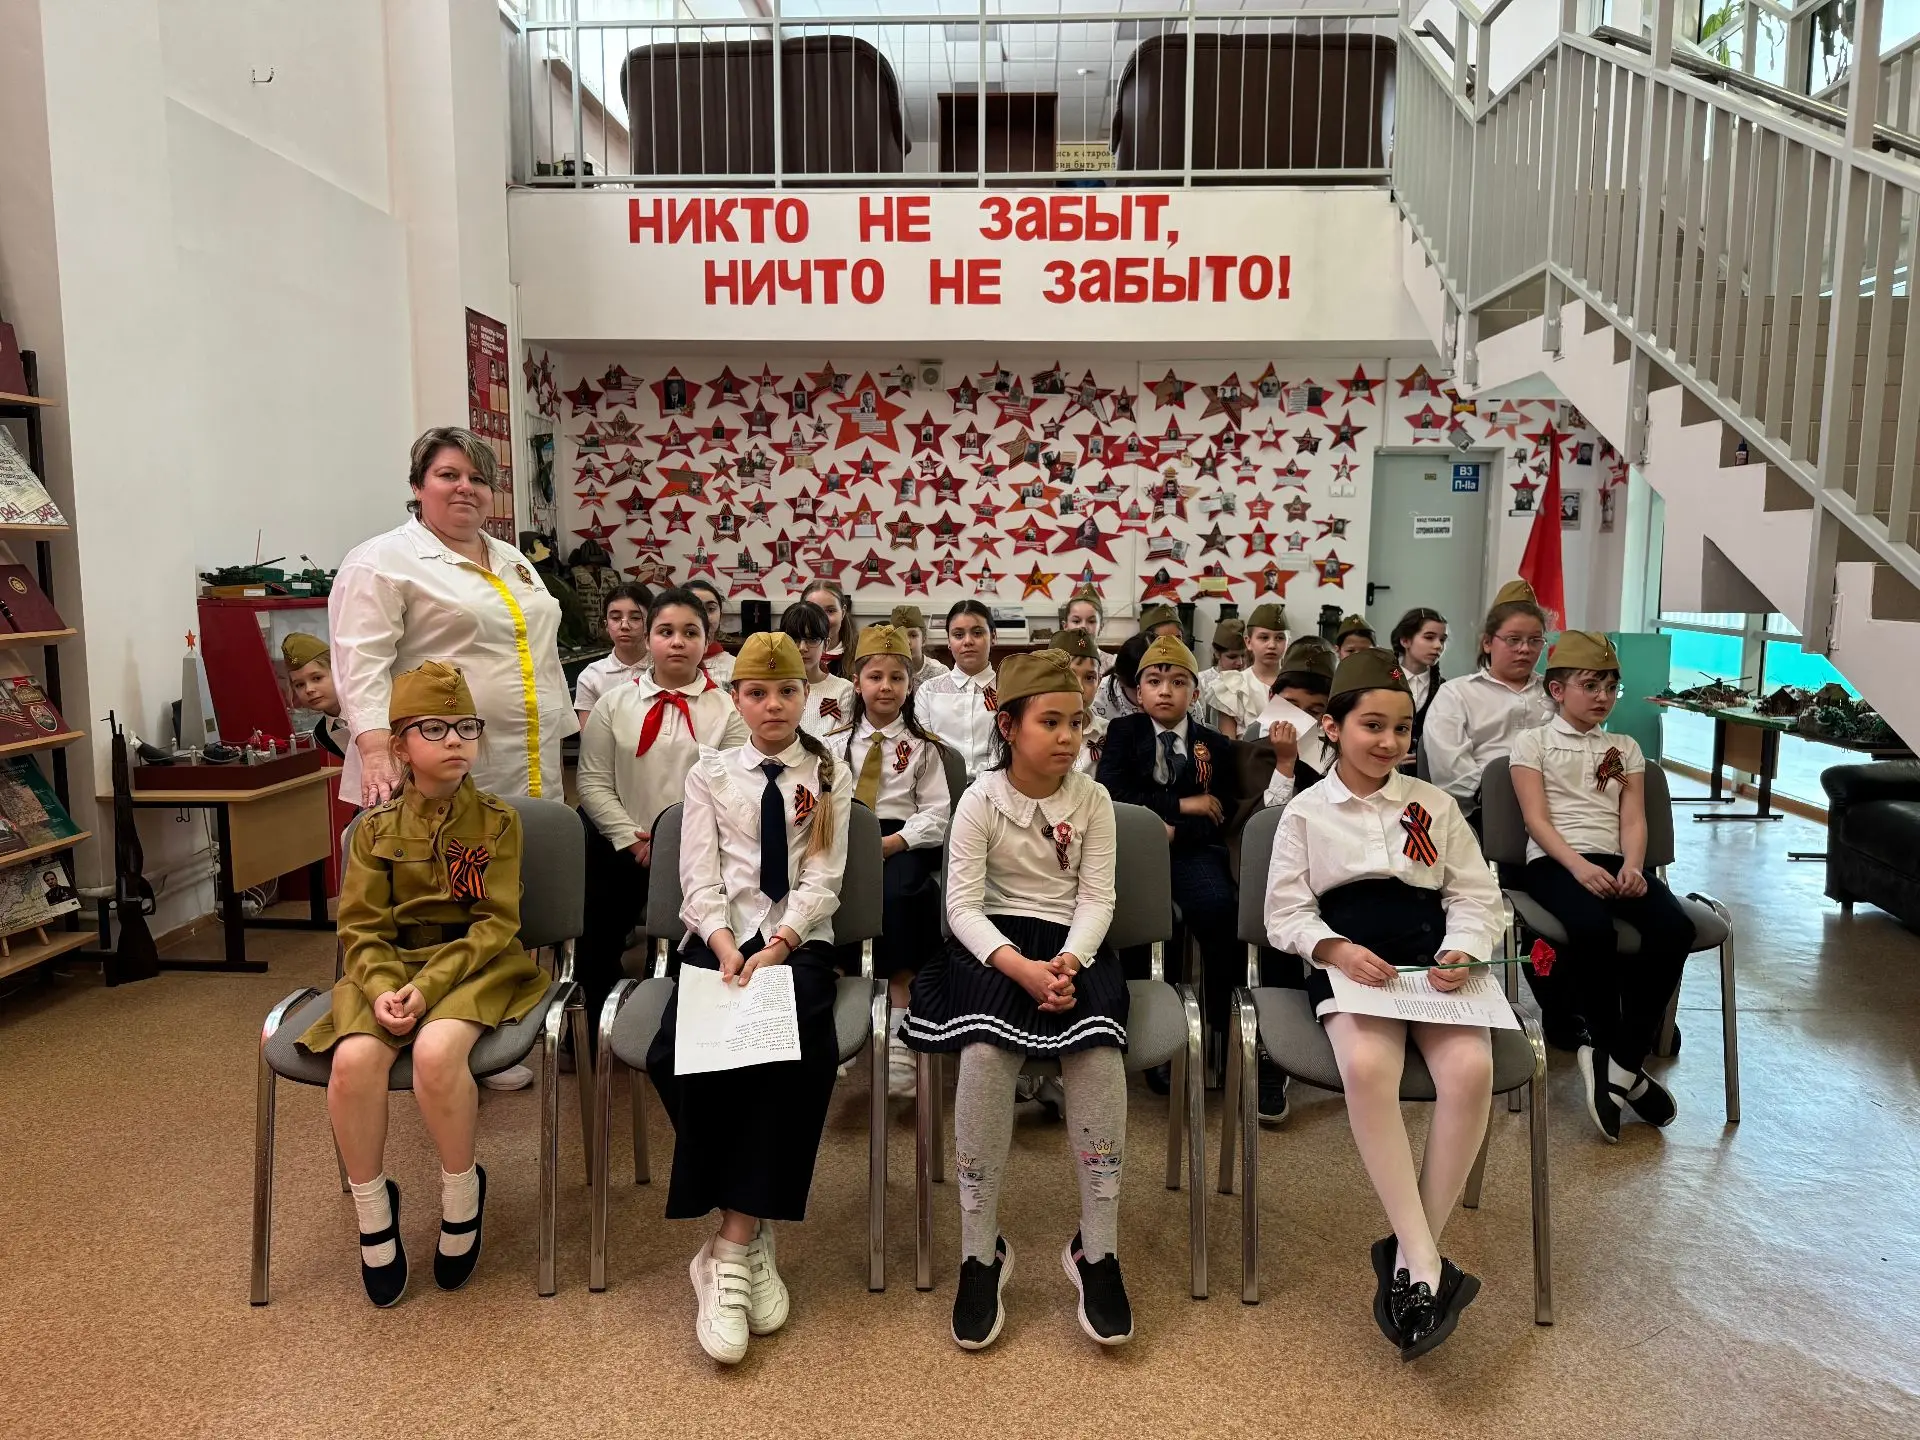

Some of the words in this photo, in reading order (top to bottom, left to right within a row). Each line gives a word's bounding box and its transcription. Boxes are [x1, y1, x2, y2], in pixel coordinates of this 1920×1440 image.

[629, 197, 810, 245] НИКТО
[859, 195, 932, 243] НЕ
[705, 257, 885, 306] НИЧТО
[929, 258, 1002, 305] НЕ
